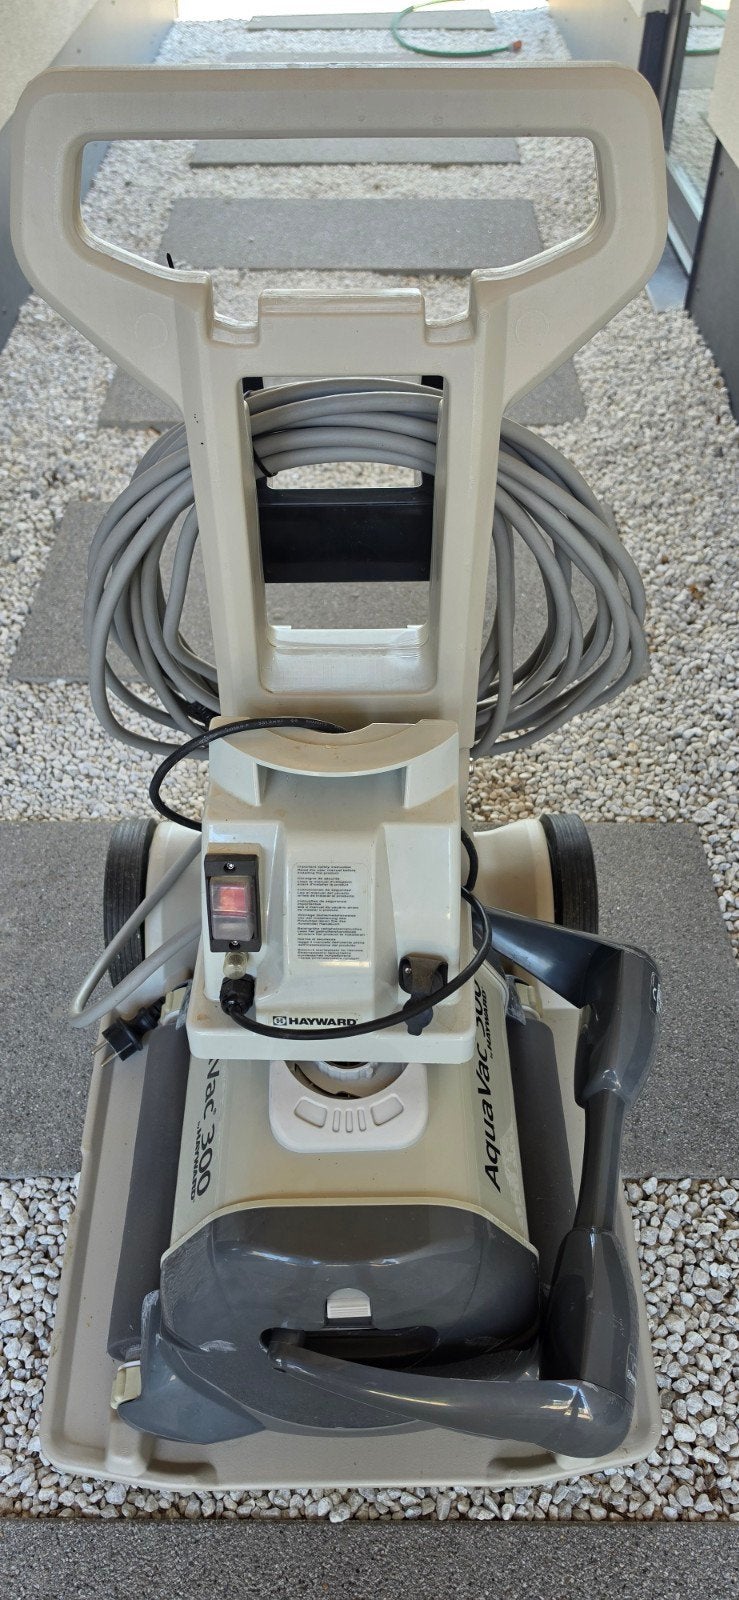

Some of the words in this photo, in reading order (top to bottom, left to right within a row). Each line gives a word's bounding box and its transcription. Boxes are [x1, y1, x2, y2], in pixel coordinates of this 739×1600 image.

[288, 1017, 358, 1026] HAYWARD
[481, 989, 493, 1051] HAYWARD
[190, 1127, 202, 1202] HAYWARD
[197, 1123, 215, 1196] 300
